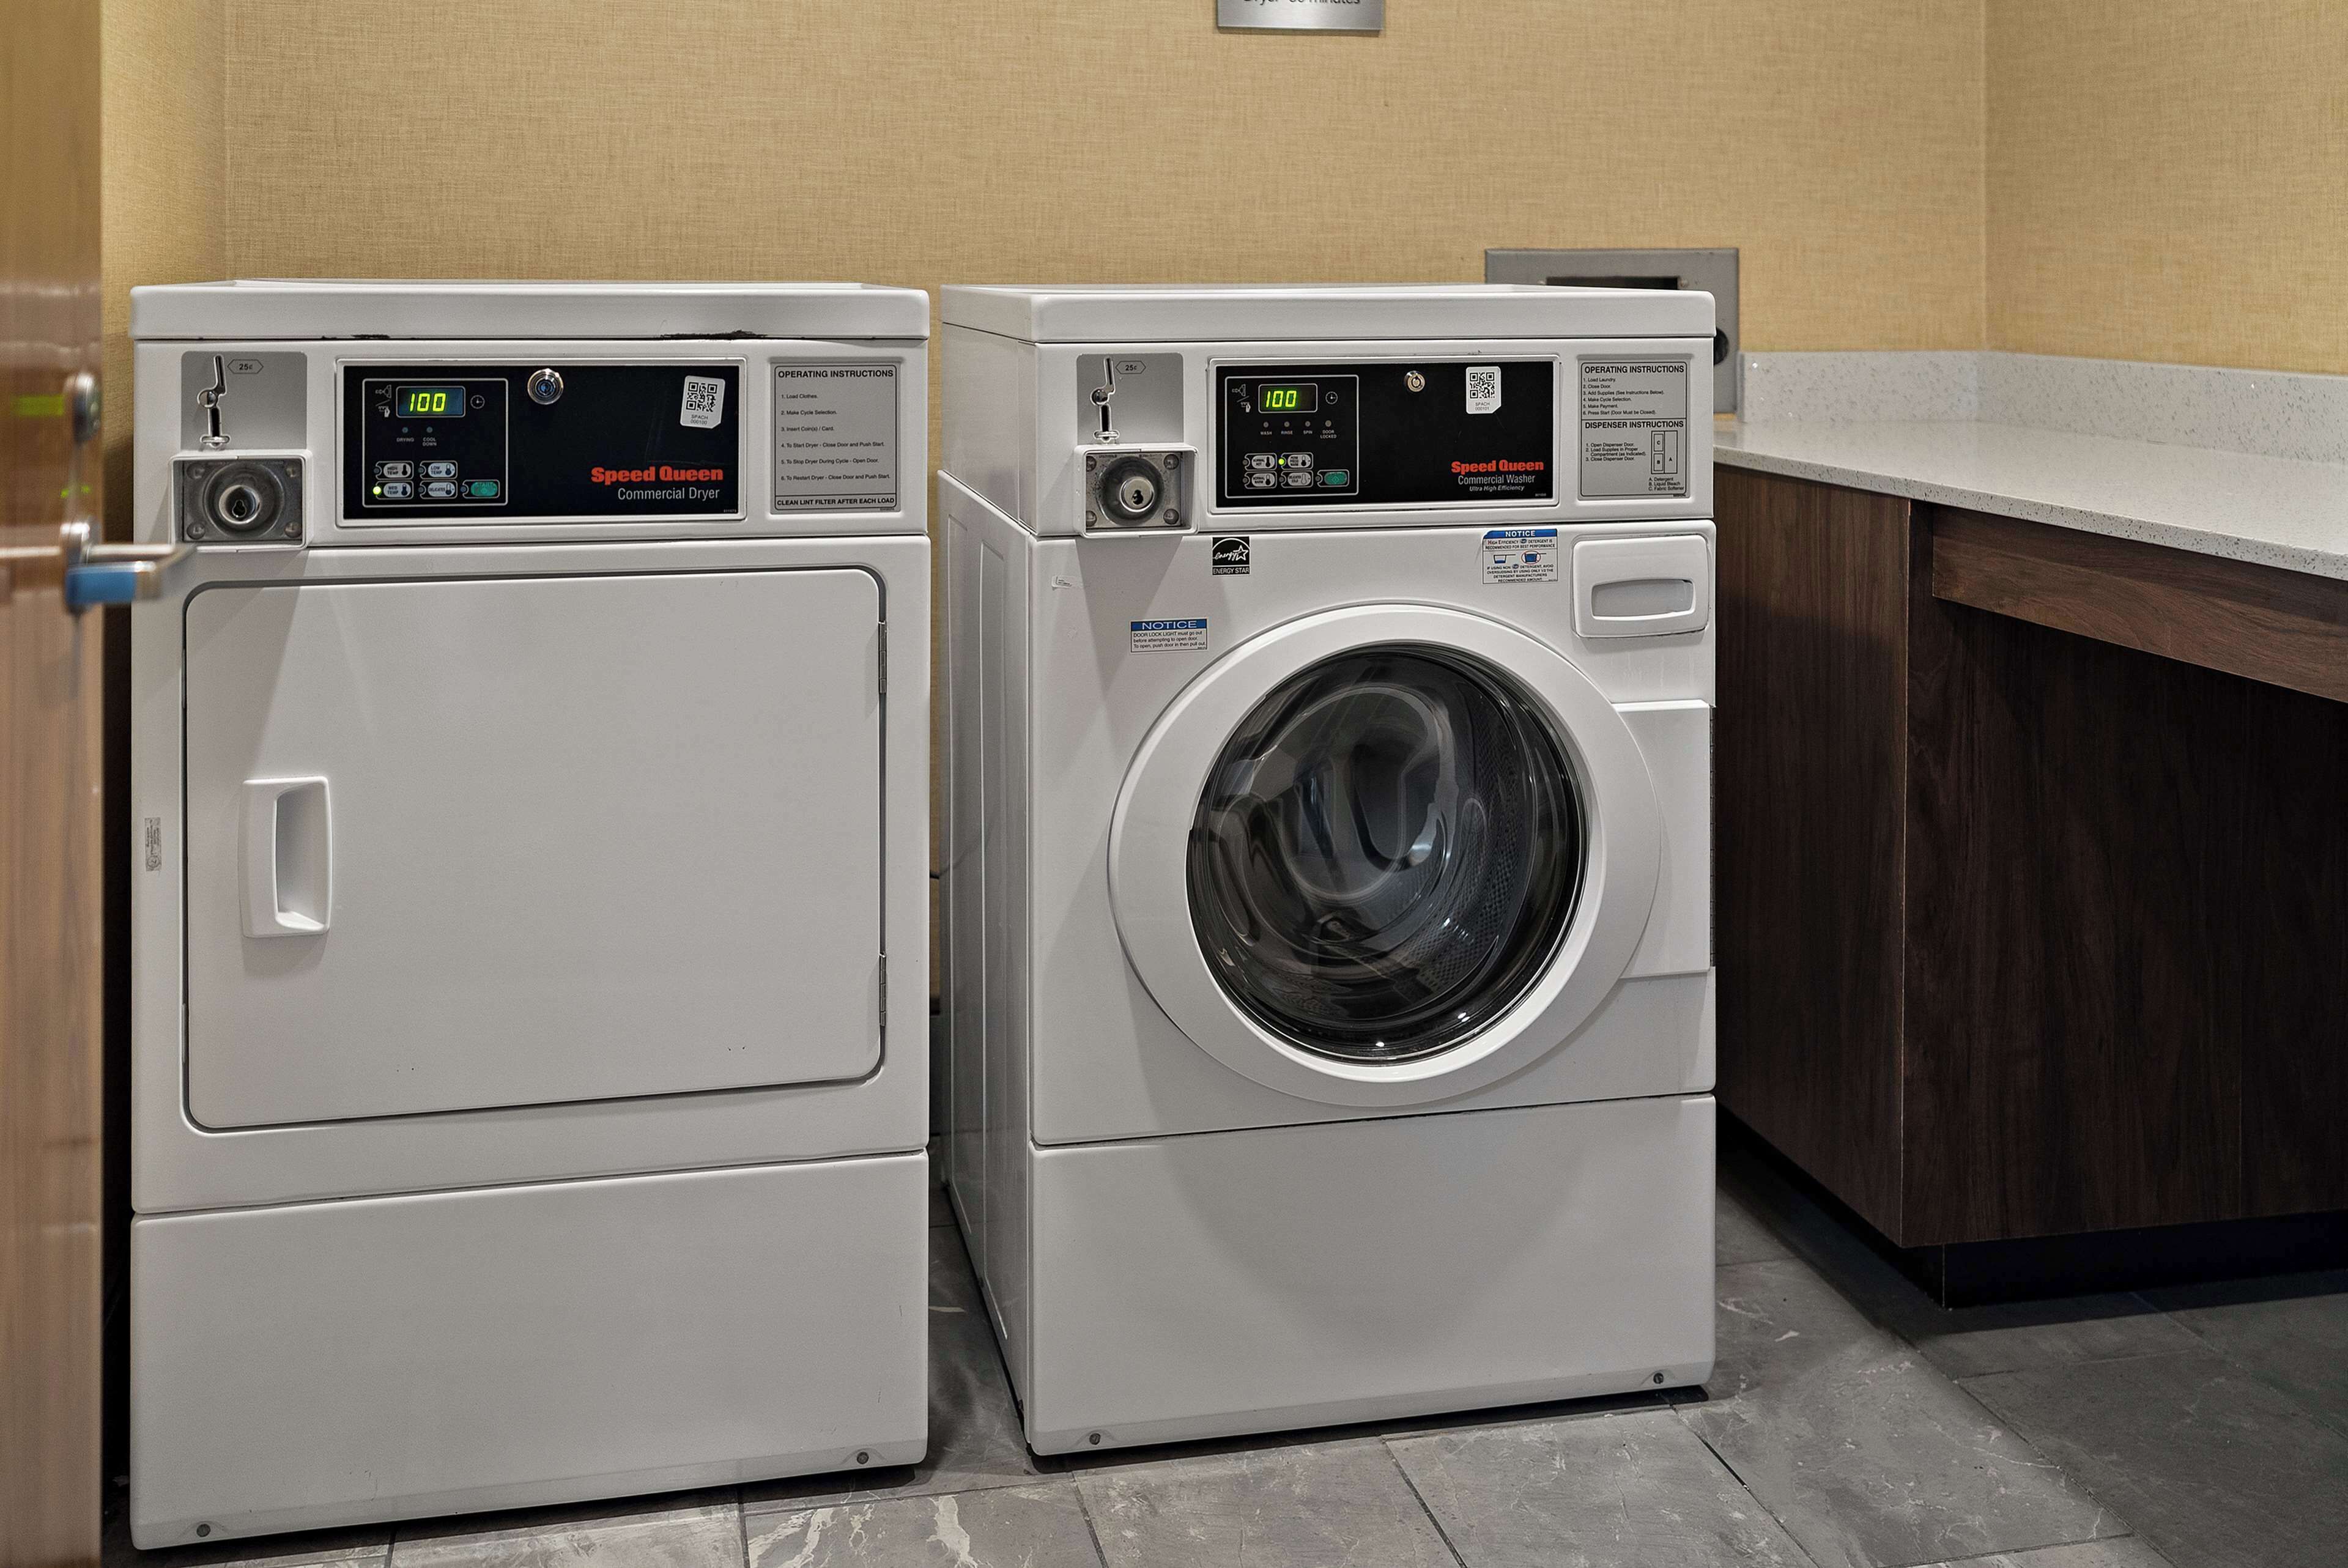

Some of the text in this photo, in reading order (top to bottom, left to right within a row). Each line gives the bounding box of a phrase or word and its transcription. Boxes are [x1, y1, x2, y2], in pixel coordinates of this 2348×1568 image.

[409, 393, 446, 412] 100
[1265, 390, 1297, 408] 100
[1451, 459, 1544, 475] Speed Queen
[591, 465, 724, 486] Speed Queen
[1458, 475, 1536, 485] Commercial Washer
[618, 487, 720, 501] Commercial Dryer
[1142, 621, 1197, 630] NOTICE
